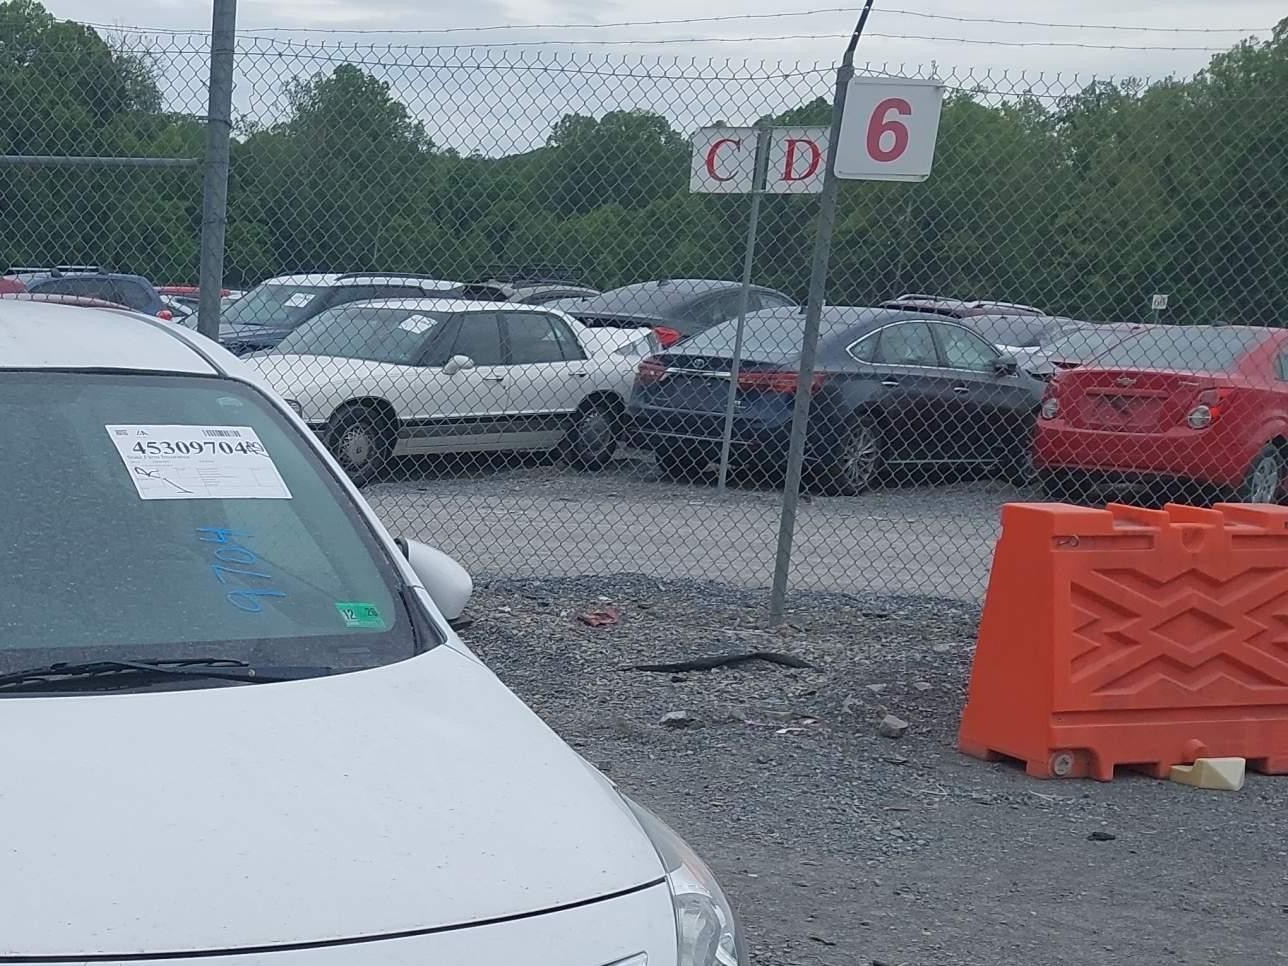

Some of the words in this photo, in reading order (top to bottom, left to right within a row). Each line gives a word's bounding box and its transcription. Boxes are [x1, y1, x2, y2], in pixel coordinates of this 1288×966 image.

[866, 97, 912, 163] 6
[706, 139, 742, 181] C
[781, 139, 821, 181] D
